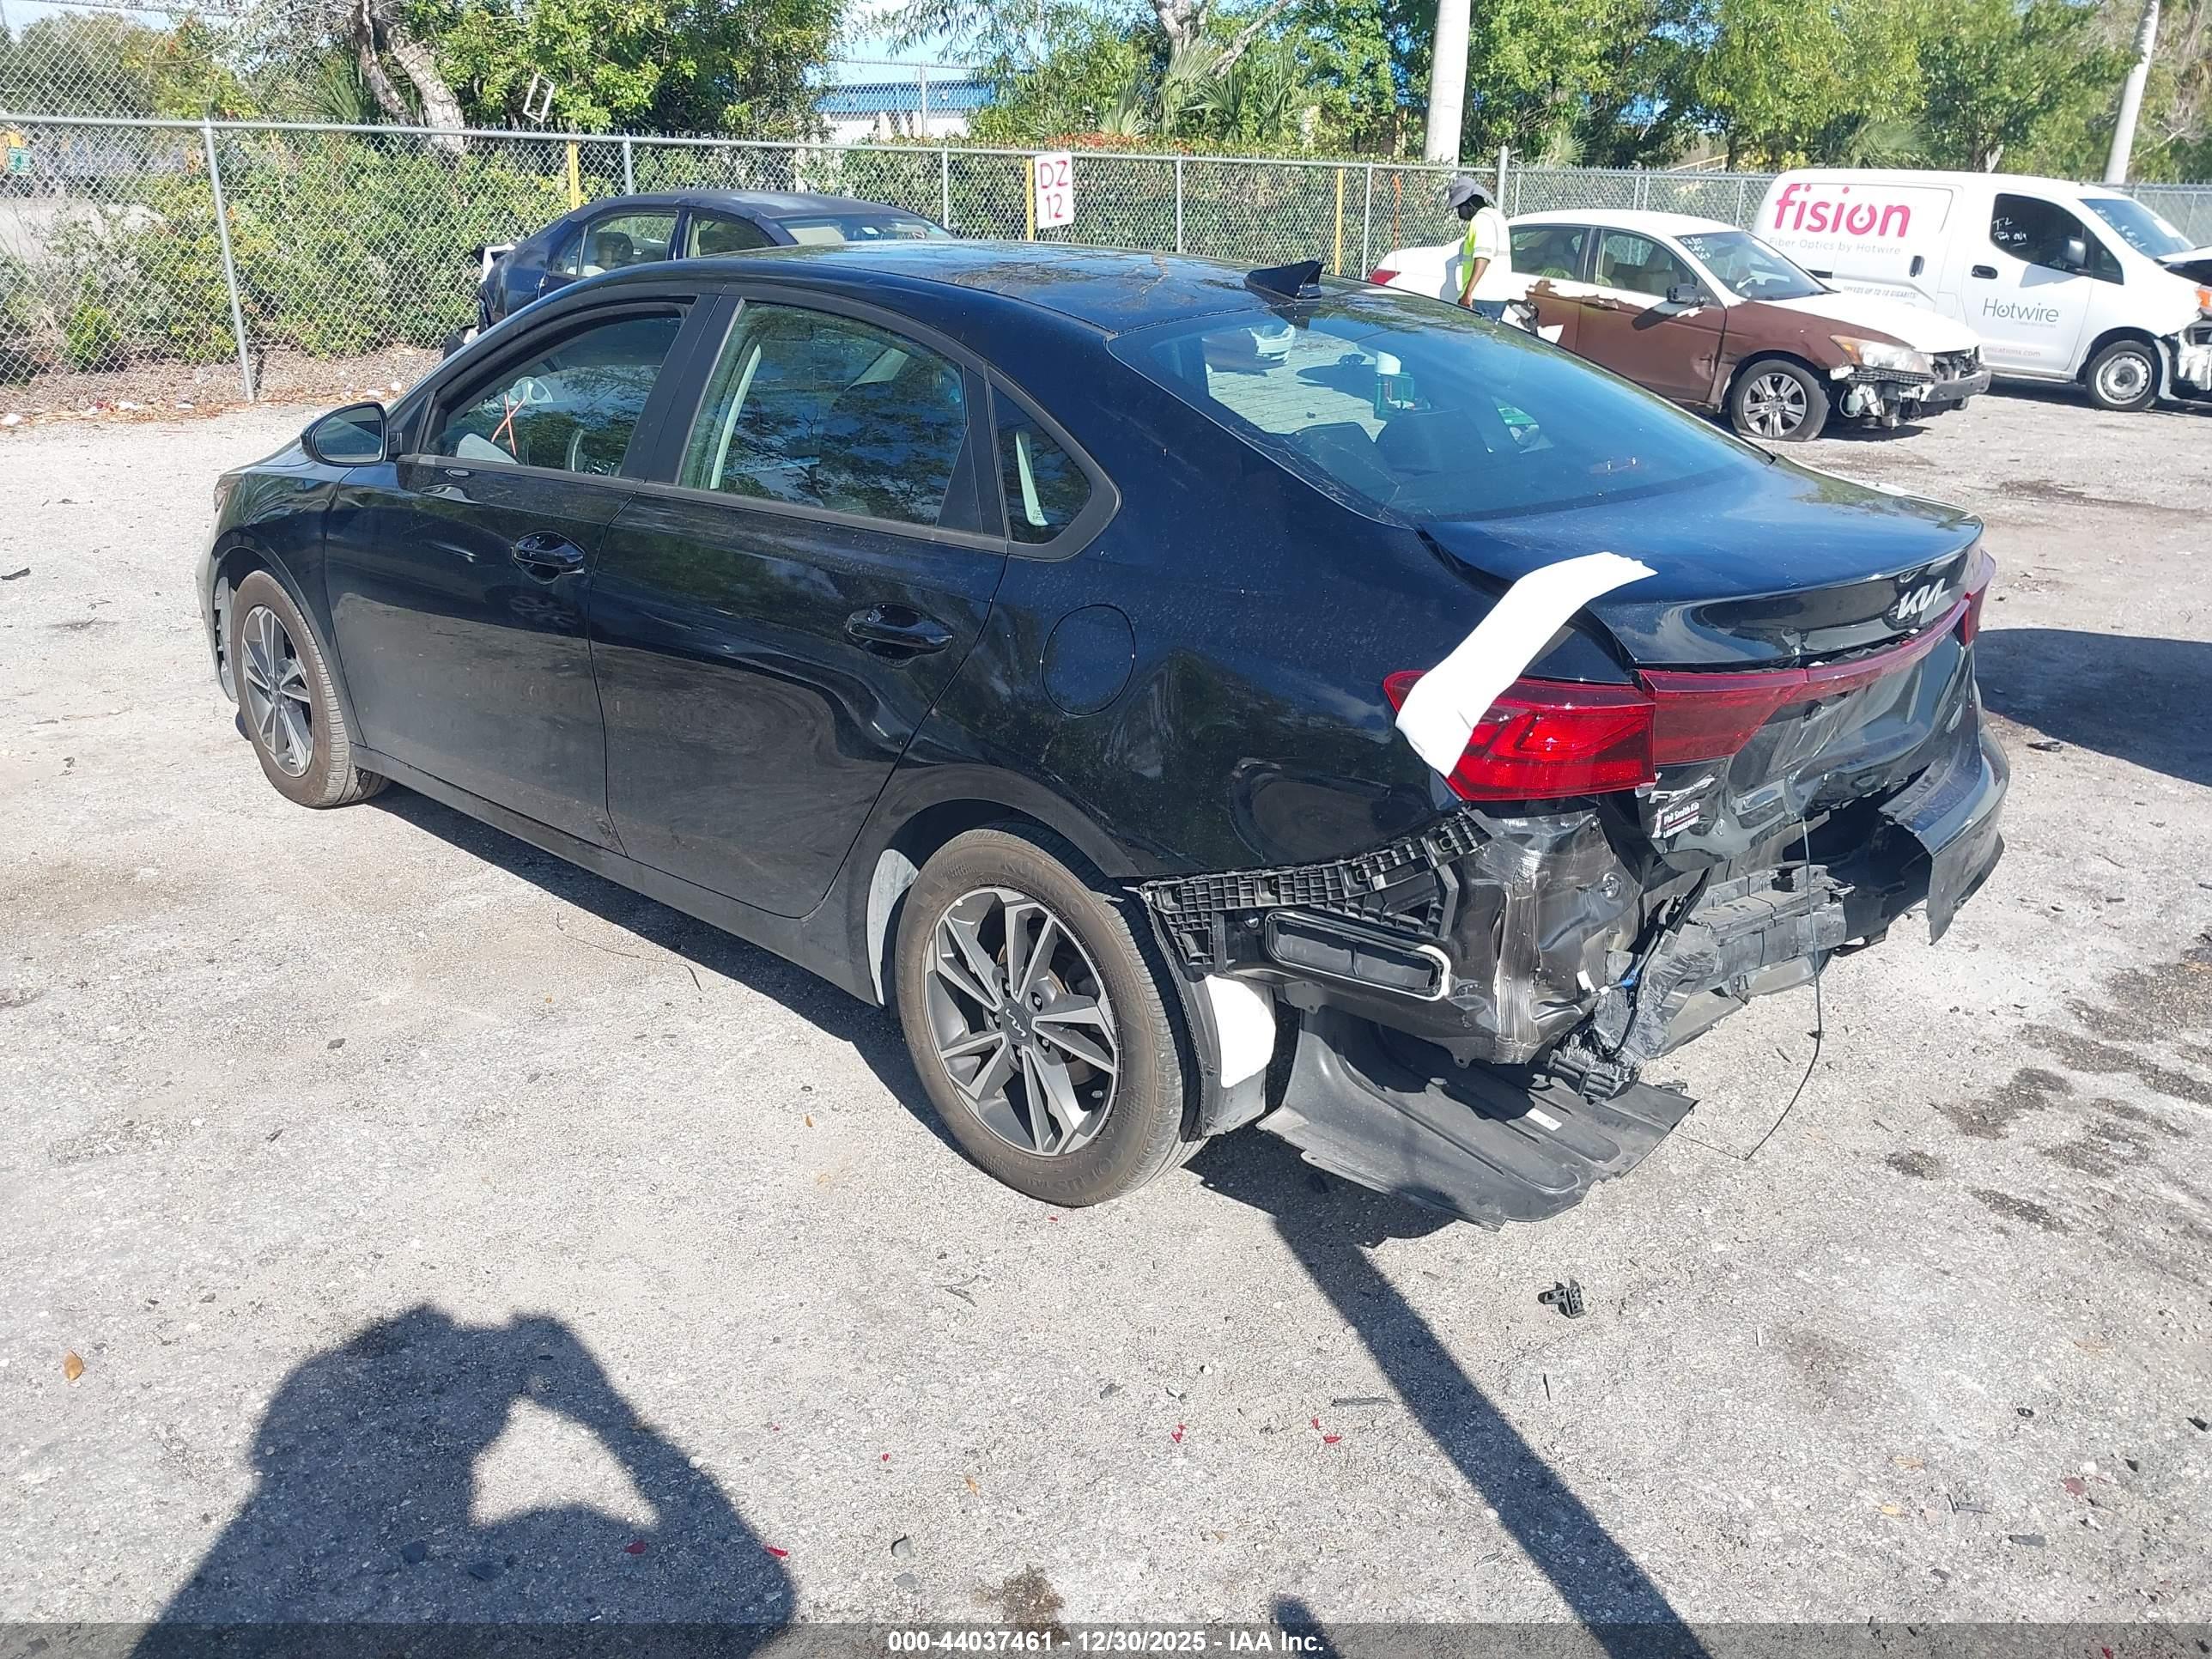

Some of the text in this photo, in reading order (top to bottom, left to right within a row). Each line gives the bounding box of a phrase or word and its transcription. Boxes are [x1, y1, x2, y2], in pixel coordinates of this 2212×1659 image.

[1046, 192, 1063, 220] 12
[1774, 183, 1911, 238] fision
[1768, 236, 1901, 255] Fiber Optics by Hotwire
[1982, 297, 2059, 322] Hotwire
